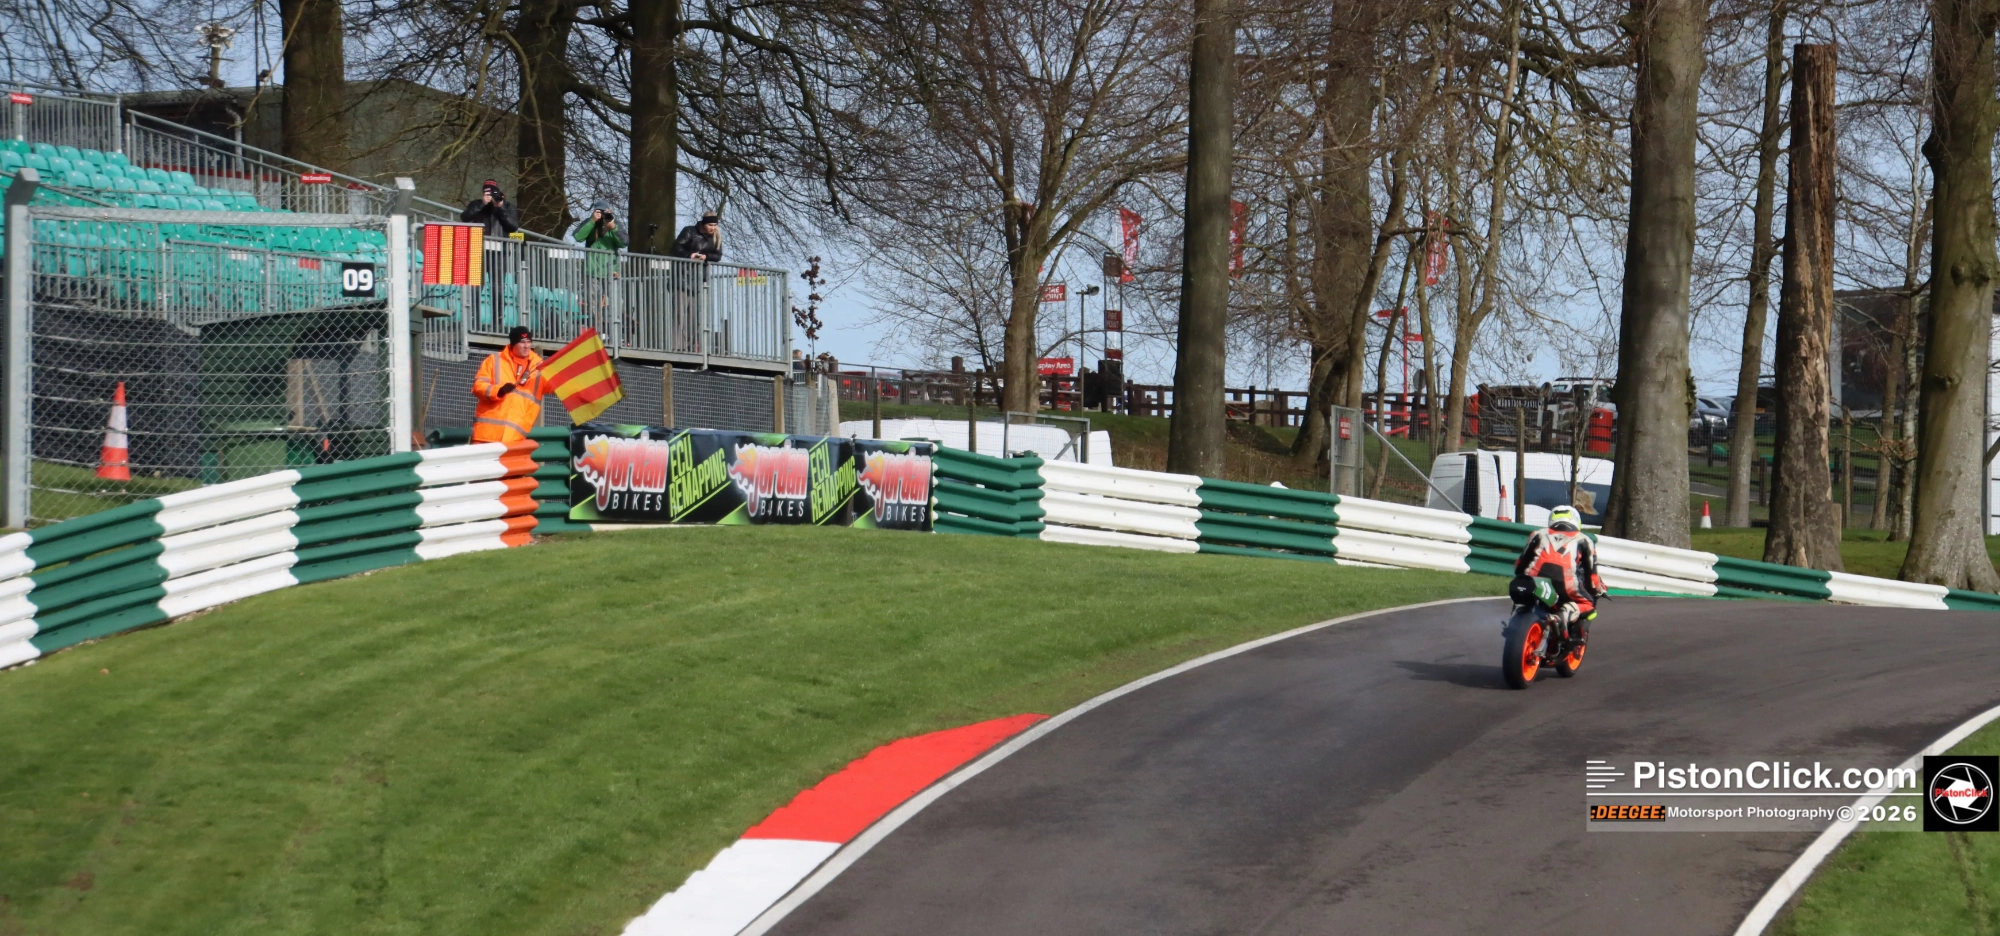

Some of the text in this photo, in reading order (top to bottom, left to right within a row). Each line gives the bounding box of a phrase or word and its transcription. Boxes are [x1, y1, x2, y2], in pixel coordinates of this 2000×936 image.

[343, 269, 373, 291] 09
[1042, 293, 1063, 301] OINT
[1037, 362, 1055, 371] splay
[669, 434, 694, 482] ECU
[809, 442, 830, 486] ECU
[669, 447, 727, 518] REMAPPING
[810, 455, 857, 523] REMAPPING
[612, 493, 662, 511] BIKES
[760, 500, 805, 517] BIKES
[886, 506, 926, 522] BIKES
